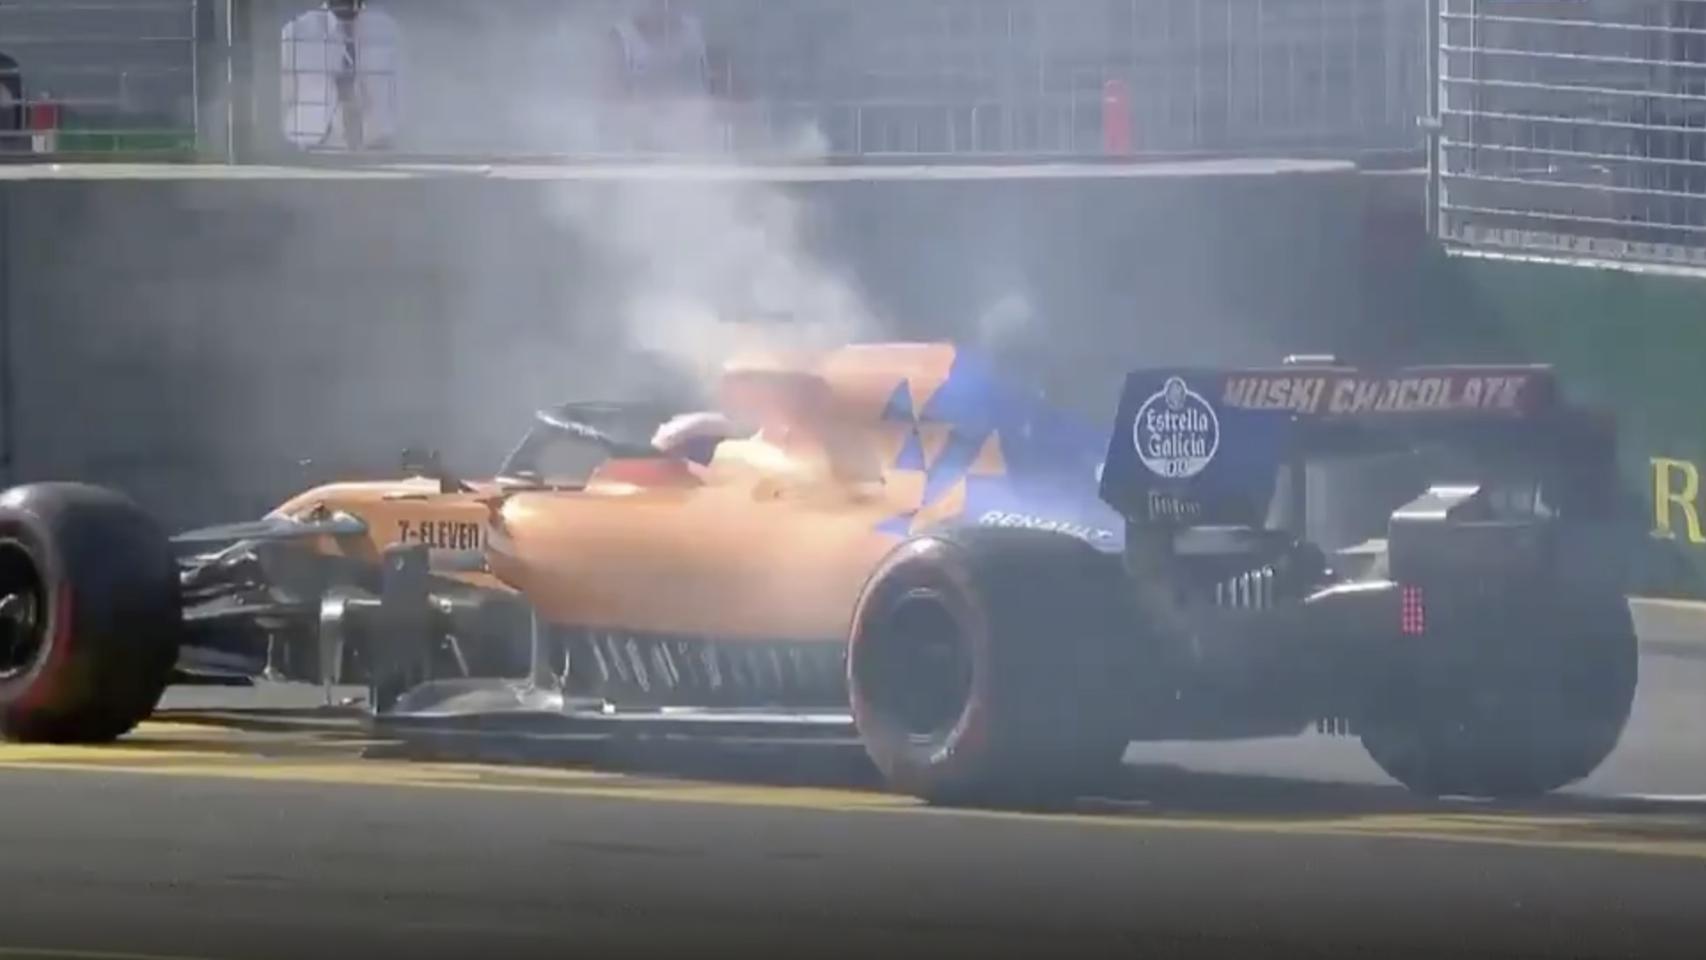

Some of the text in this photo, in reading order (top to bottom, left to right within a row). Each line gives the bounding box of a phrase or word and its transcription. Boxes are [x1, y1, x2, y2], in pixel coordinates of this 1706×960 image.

[1328, 376, 1527, 413] CHOCOLATE
[1146, 408, 1209, 432] Estrella
[1149, 432, 1206, 457] Galicia
